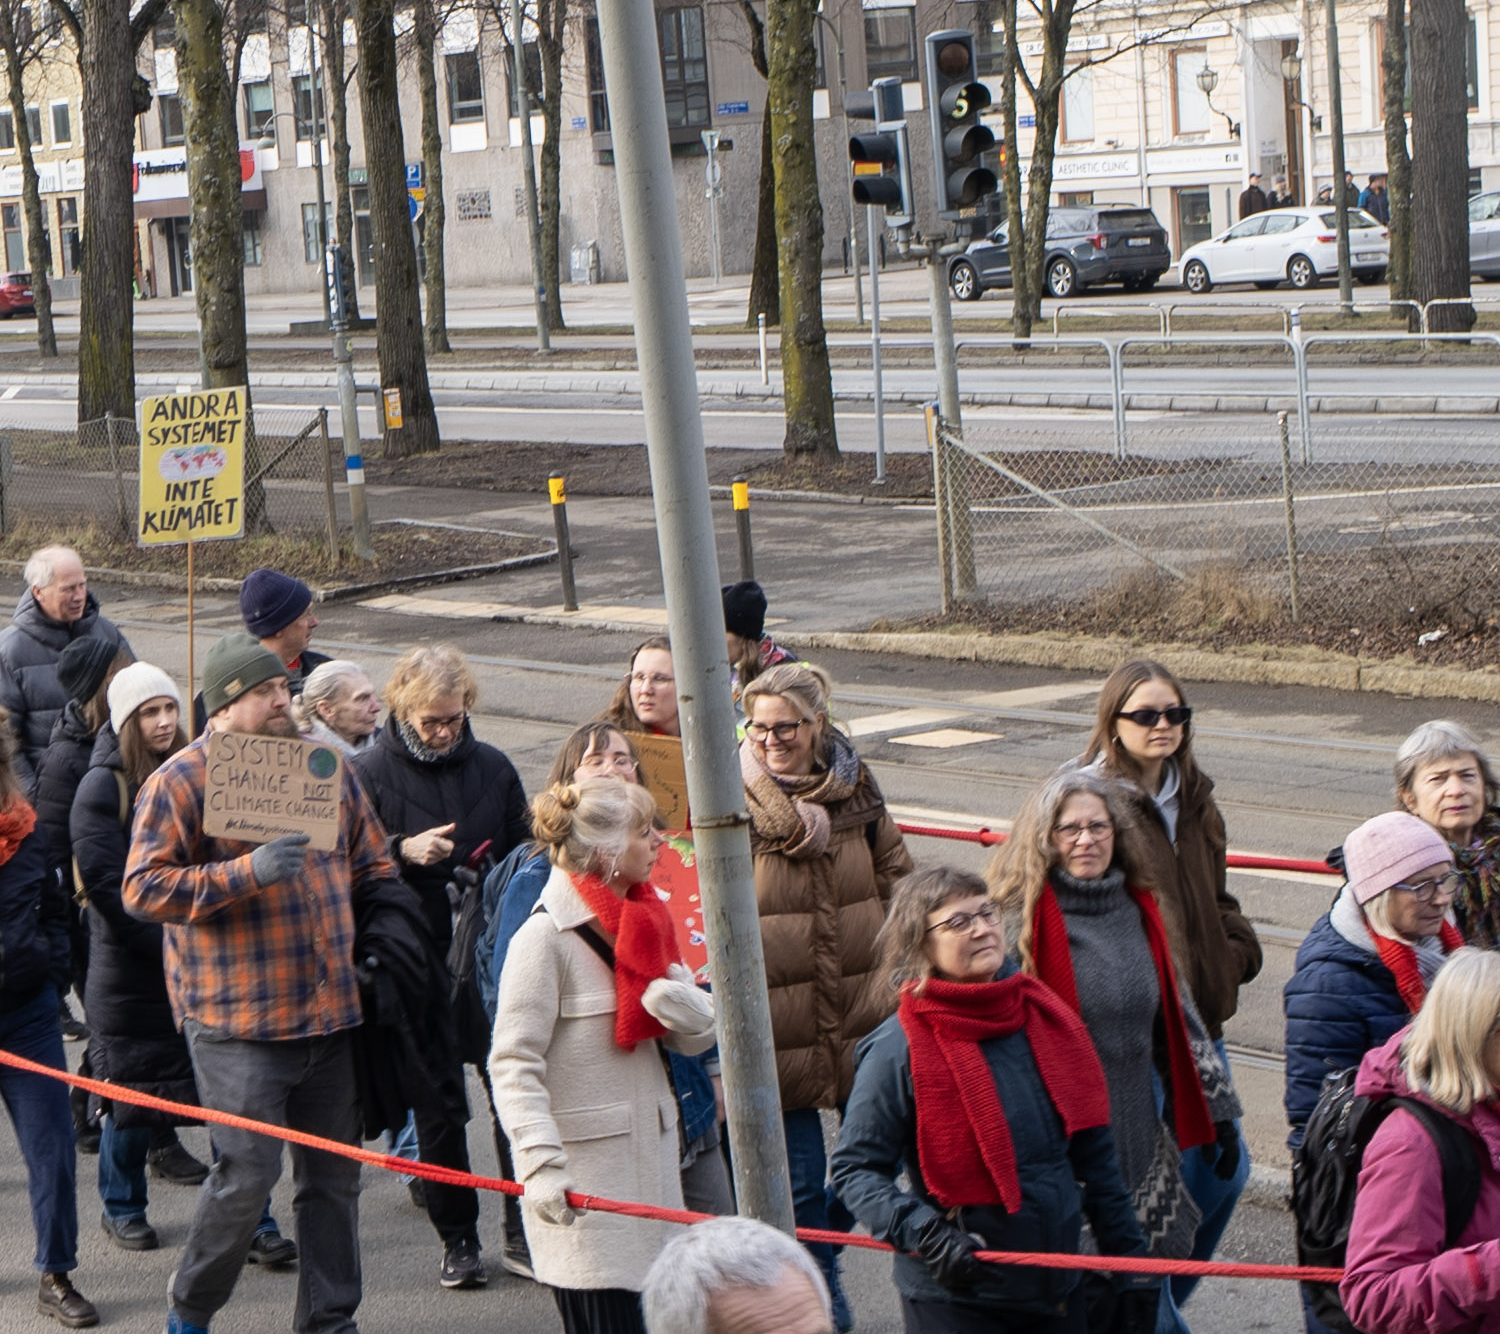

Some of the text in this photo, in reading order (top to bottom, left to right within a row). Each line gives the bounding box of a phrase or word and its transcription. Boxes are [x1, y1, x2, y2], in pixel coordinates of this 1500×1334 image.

[408, 166, 417, 179] P
[1058, 159, 1100, 174] AESTHETIC
[1102, 159, 1129, 172] CLINIC
[150, 390, 239, 423] ÄNDRA
[148, 419, 241, 447] SYSTEMET
[165, 477, 215, 503] INTE
[141, 497, 239, 535] KLIMATET
[216, 733, 304, 769] SYSTEM
[209, 763, 334, 799] CHANGE NOT
[209, 790, 337, 820] CLIMATE CHANGE
